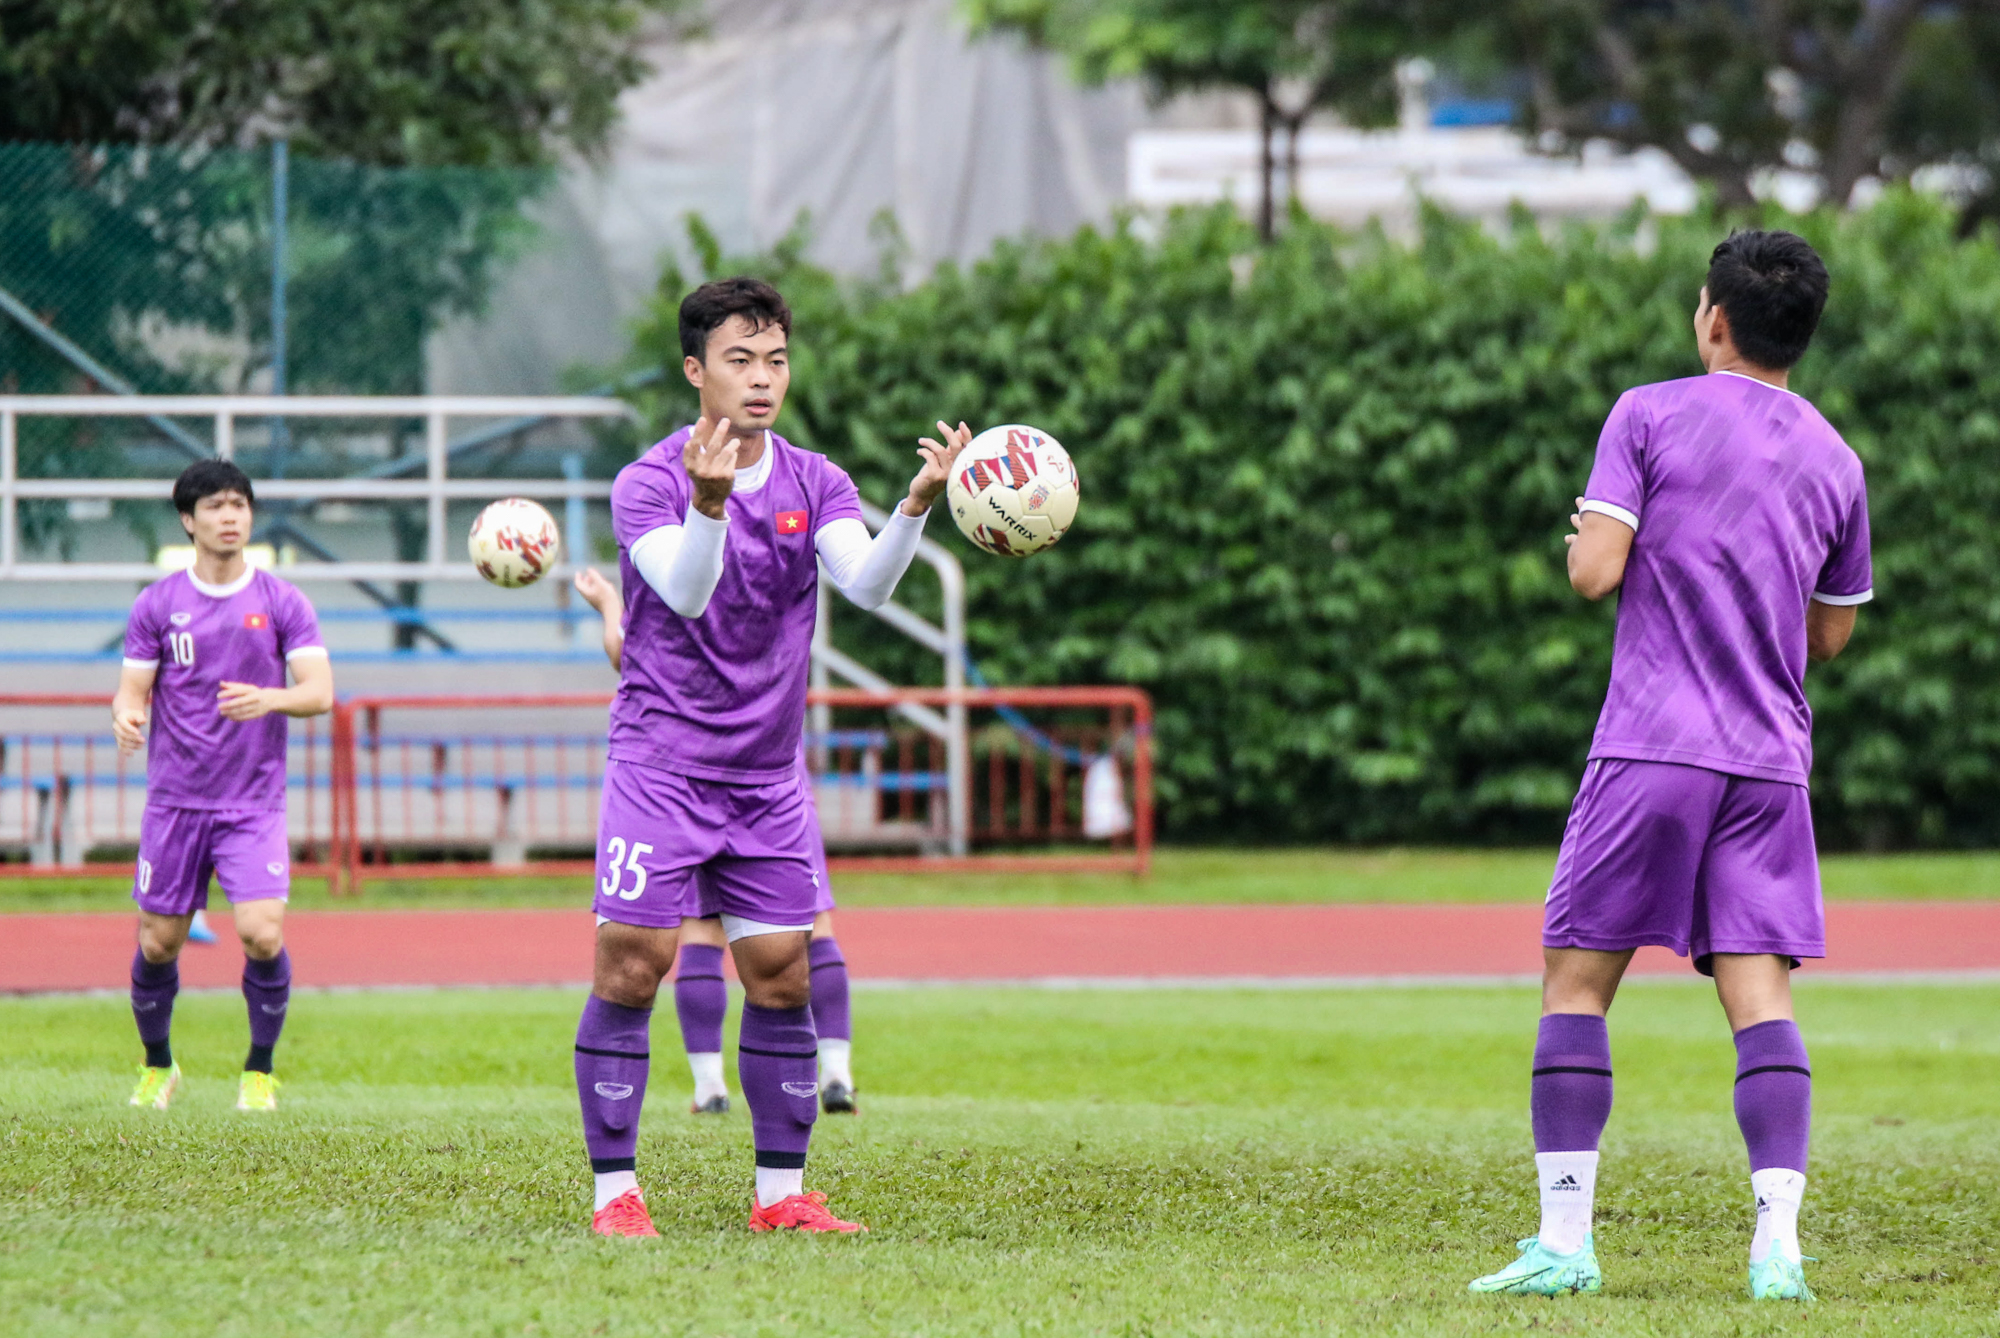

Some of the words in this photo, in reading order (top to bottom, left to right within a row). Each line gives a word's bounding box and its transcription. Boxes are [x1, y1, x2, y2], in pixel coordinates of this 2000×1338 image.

[989, 496, 1037, 541] WARRIX
[169, 631, 195, 666] 10
[601, 836, 654, 901] 35
